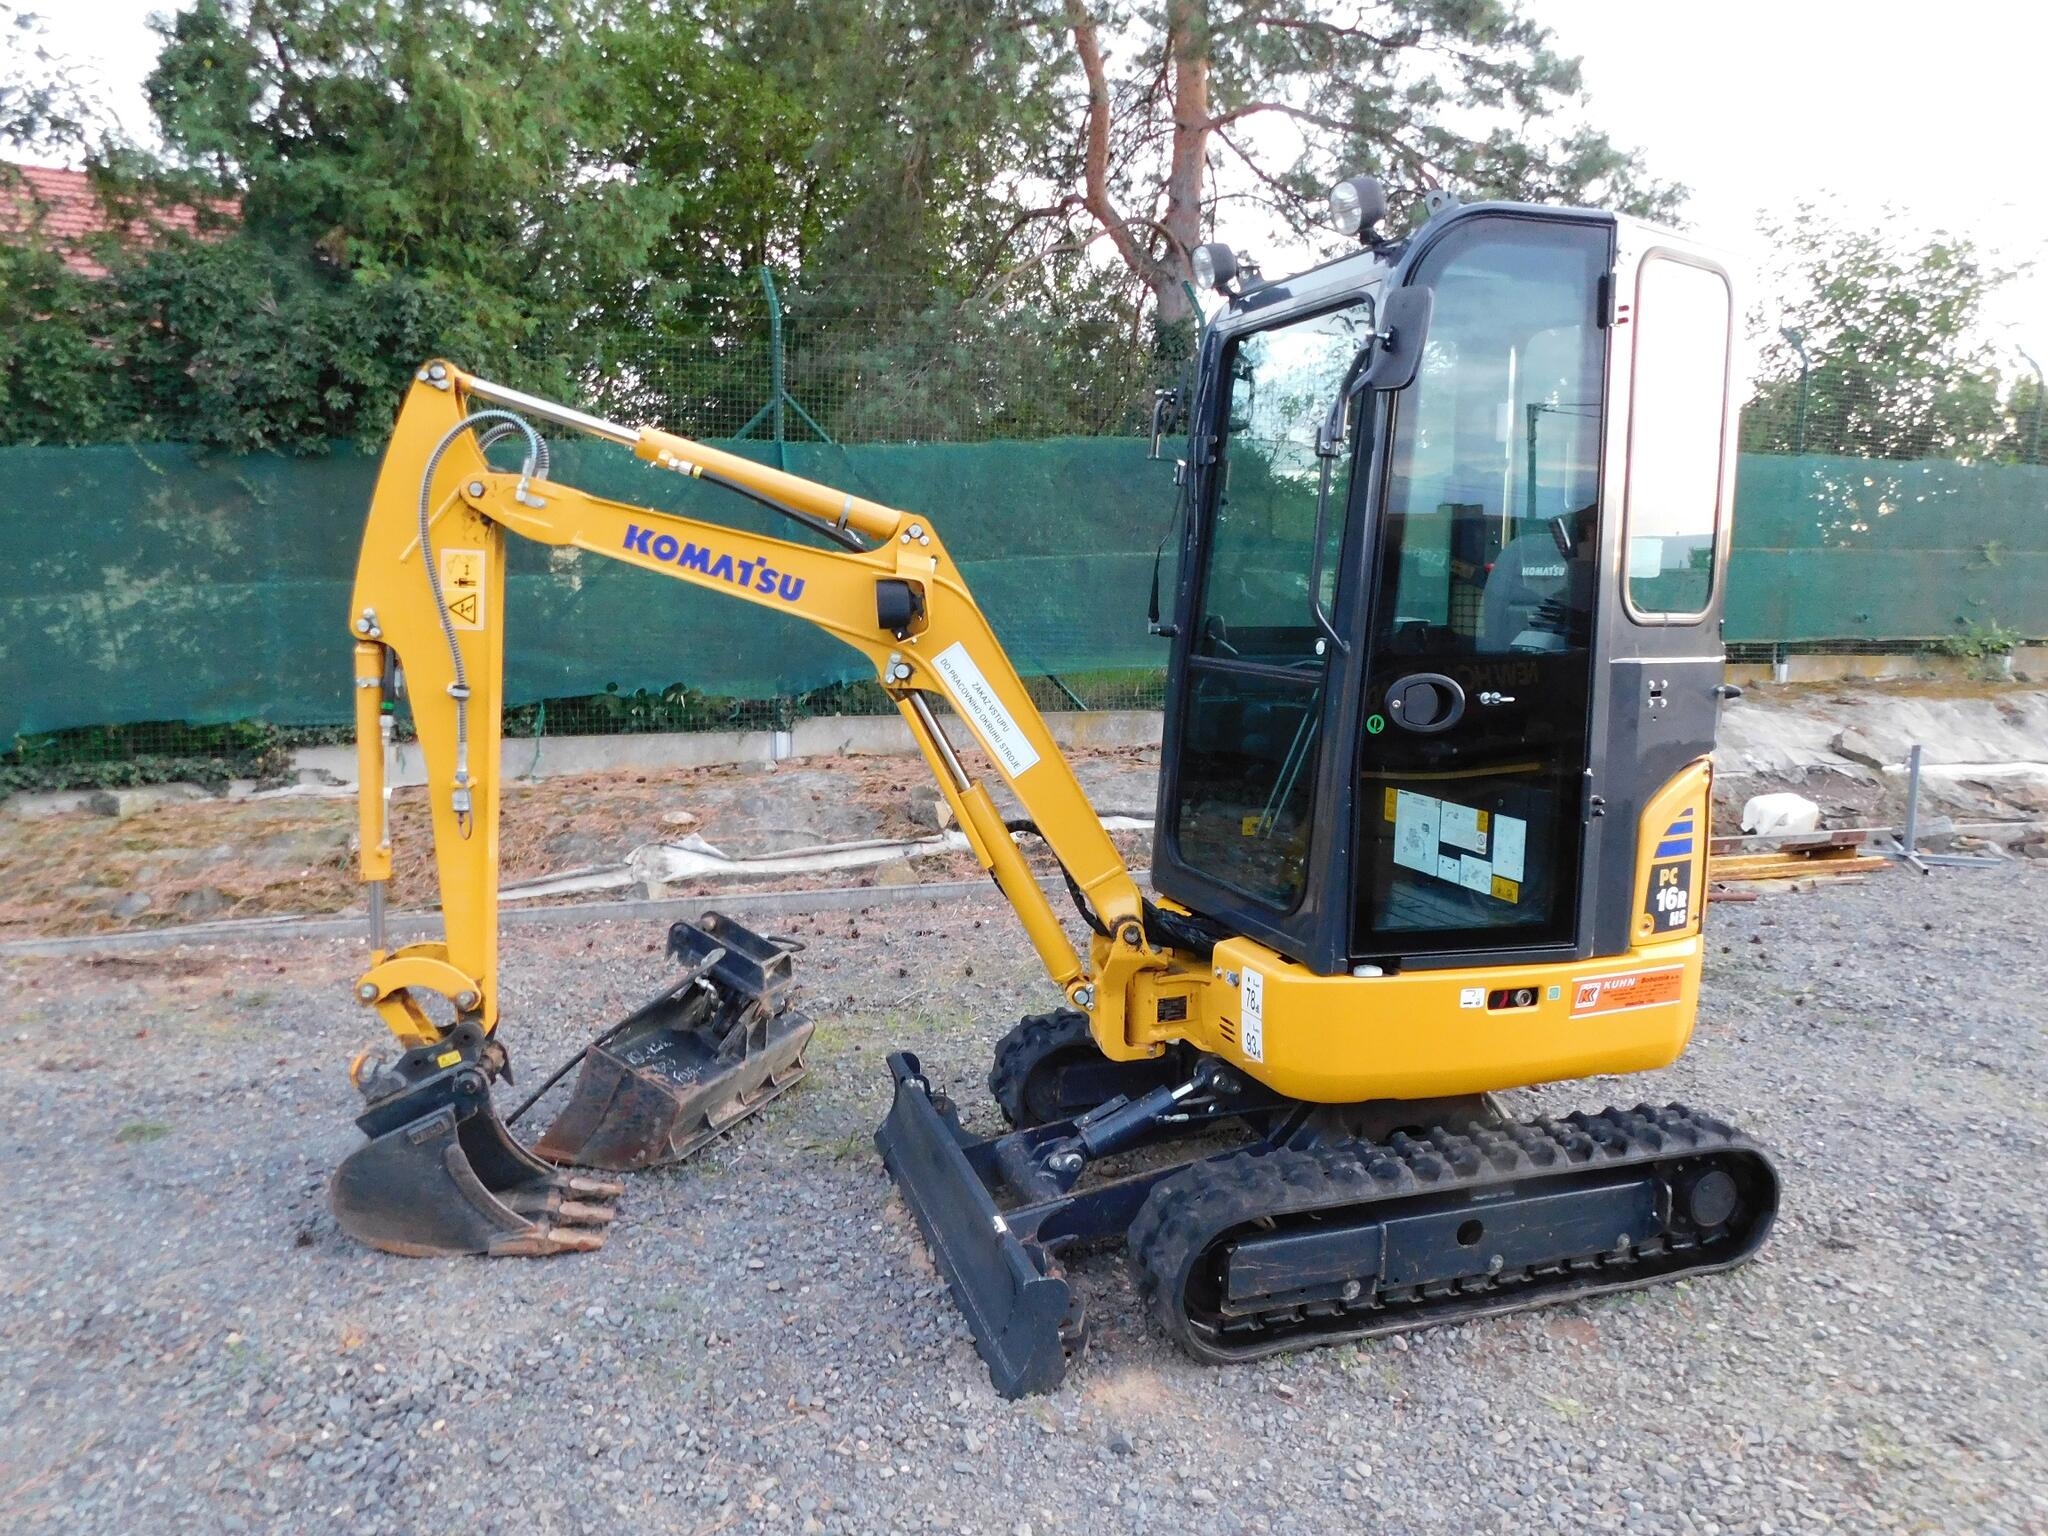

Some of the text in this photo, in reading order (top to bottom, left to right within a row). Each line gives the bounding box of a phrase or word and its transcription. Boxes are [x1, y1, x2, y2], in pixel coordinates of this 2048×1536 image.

[623, 524, 805, 601] KOMATSU
[1522, 565, 1565, 576] KOMATSU
[940, 658, 951, 671] DO
[978, 713, 1002, 743] OKRUHU
[999, 742, 1021, 769] STROJE
[988, 705, 1009, 732] VSTUPU
[1659, 867, 1678, 887] PC
[1656, 886, 1688, 912] 16R
[1669, 909, 1686, 926] HS
[1603, 978, 1636, 990] KUHN
[1246, 987, 1255, 1010] 78
[1247, 1032, 1256, 1055] 93
